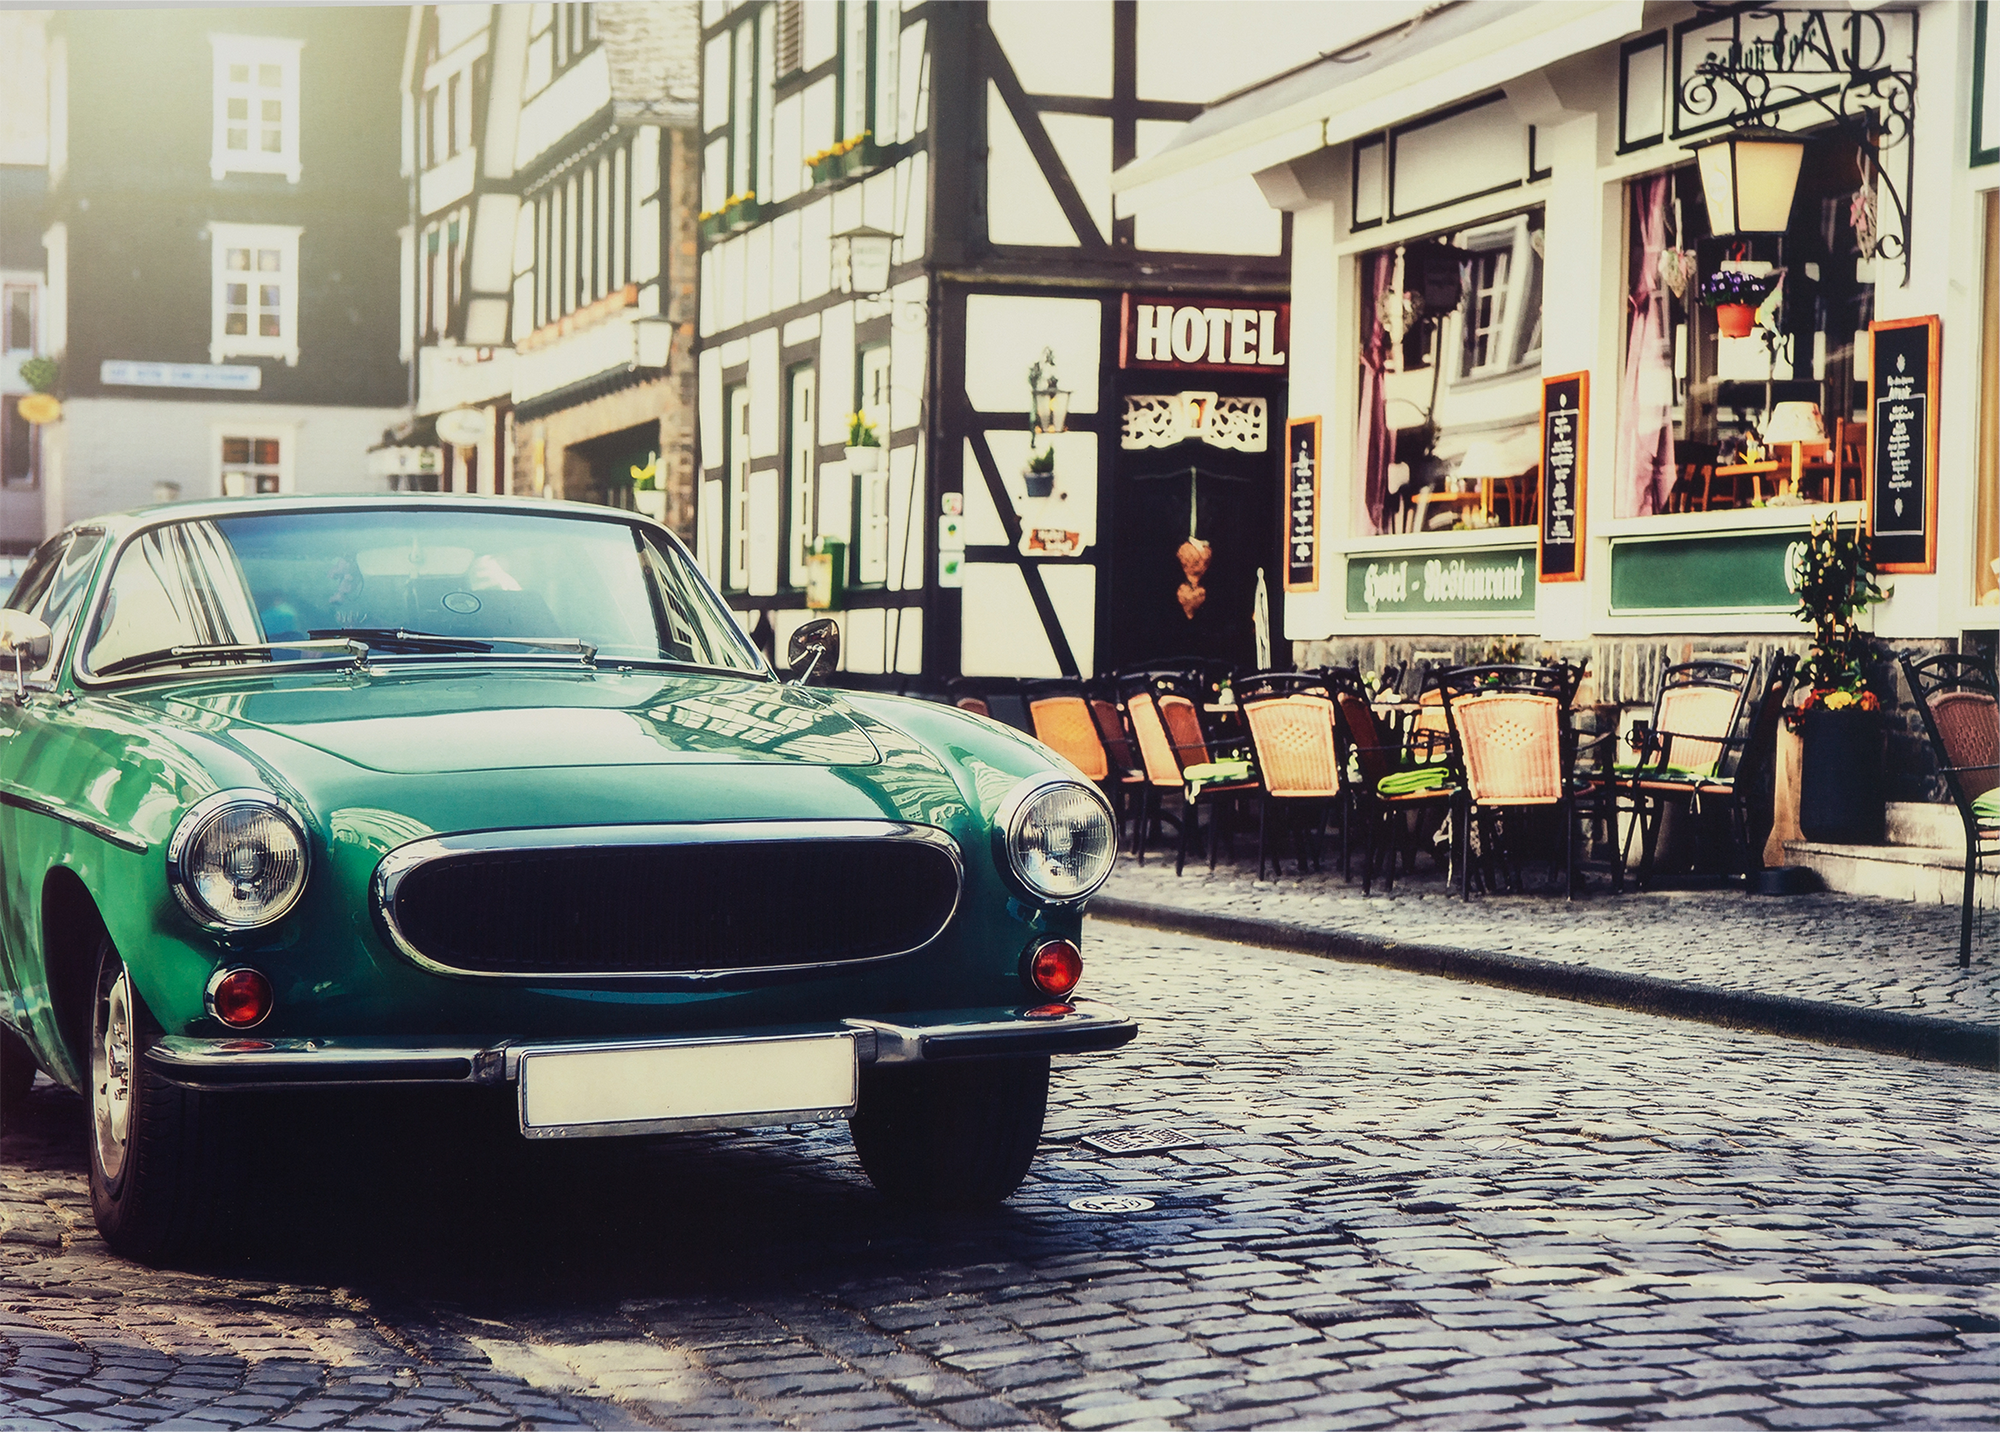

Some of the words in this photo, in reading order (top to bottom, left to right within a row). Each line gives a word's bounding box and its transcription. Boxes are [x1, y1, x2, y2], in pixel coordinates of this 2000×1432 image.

[1136, 305, 1285, 365] HOTEL
[1364, 561, 1409, 613] Hotel
[1424, 556, 1526, 602] Restaurant
